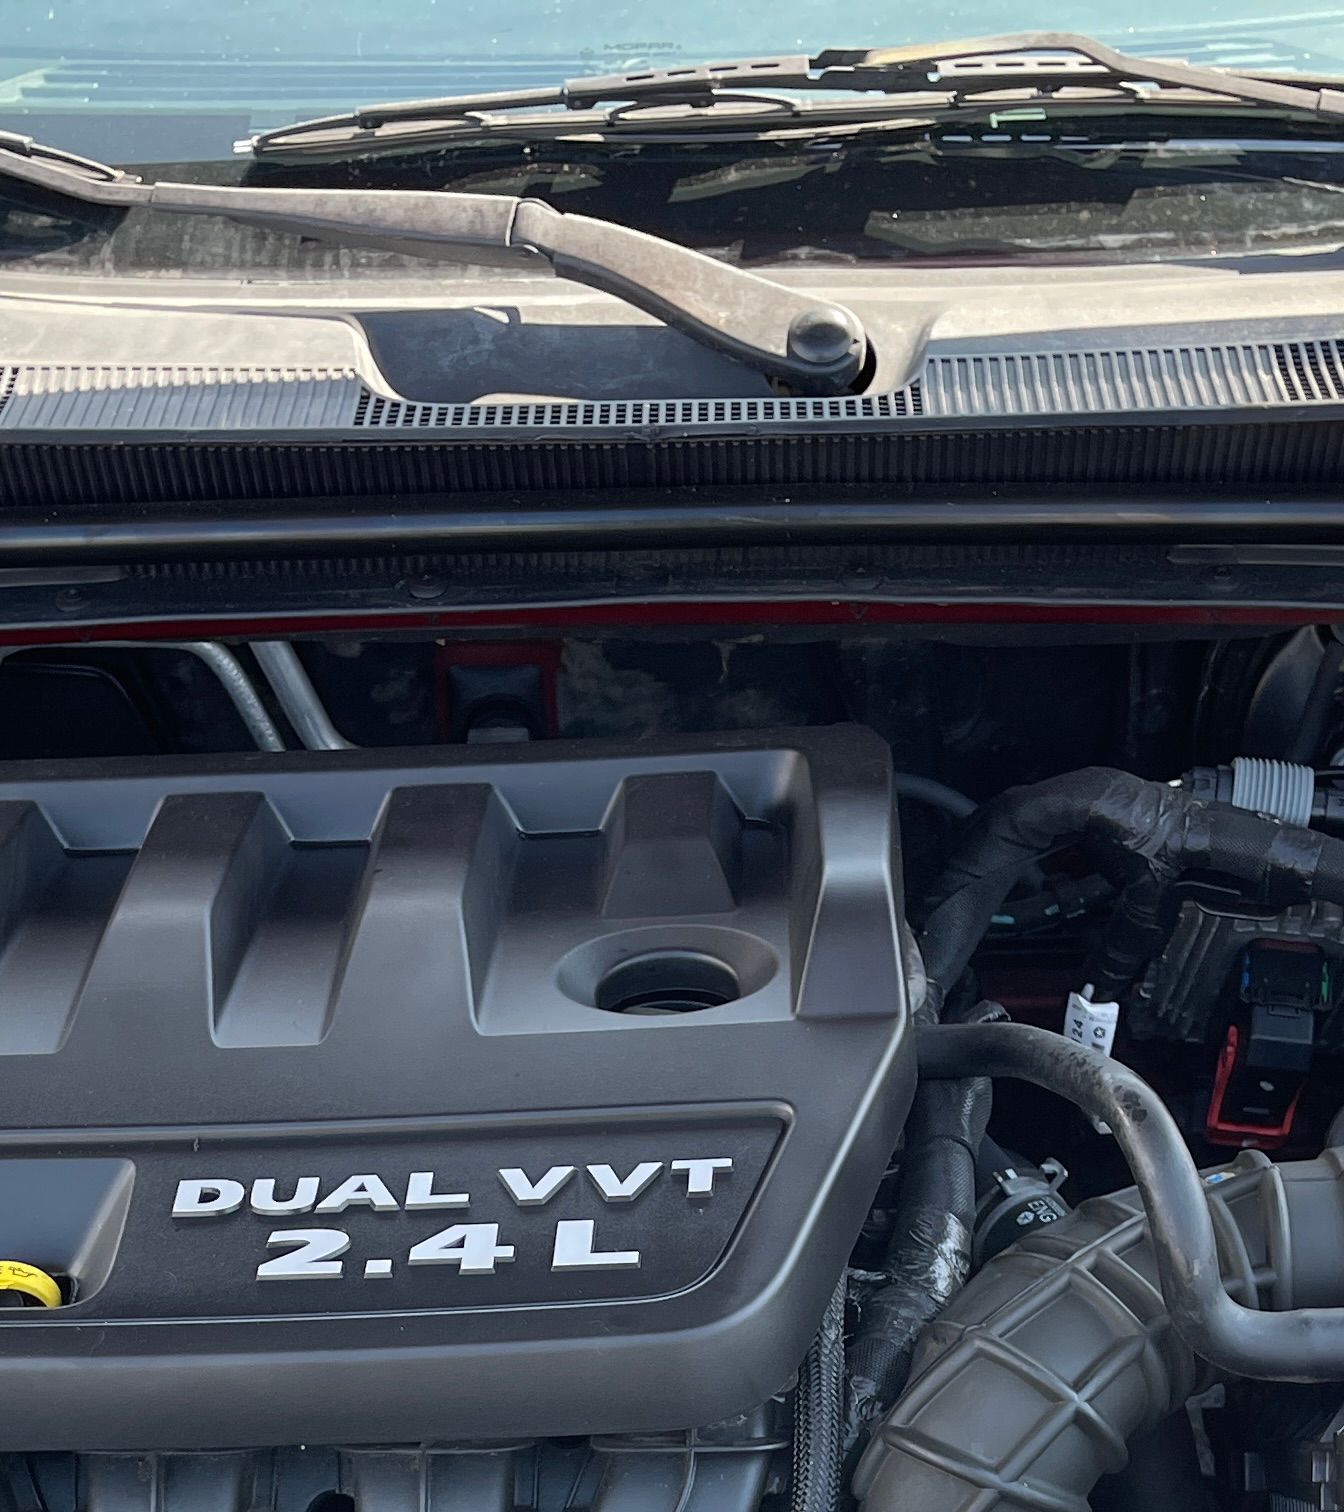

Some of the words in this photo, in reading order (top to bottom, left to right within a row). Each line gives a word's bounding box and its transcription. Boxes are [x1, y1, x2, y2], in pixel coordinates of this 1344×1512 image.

[172, 1171, 470, 1217] DUAL
[498, 1157, 733, 1204] VVT
[255, 1223, 515, 1280] 2.4
[551, 1219, 642, 1272] L
